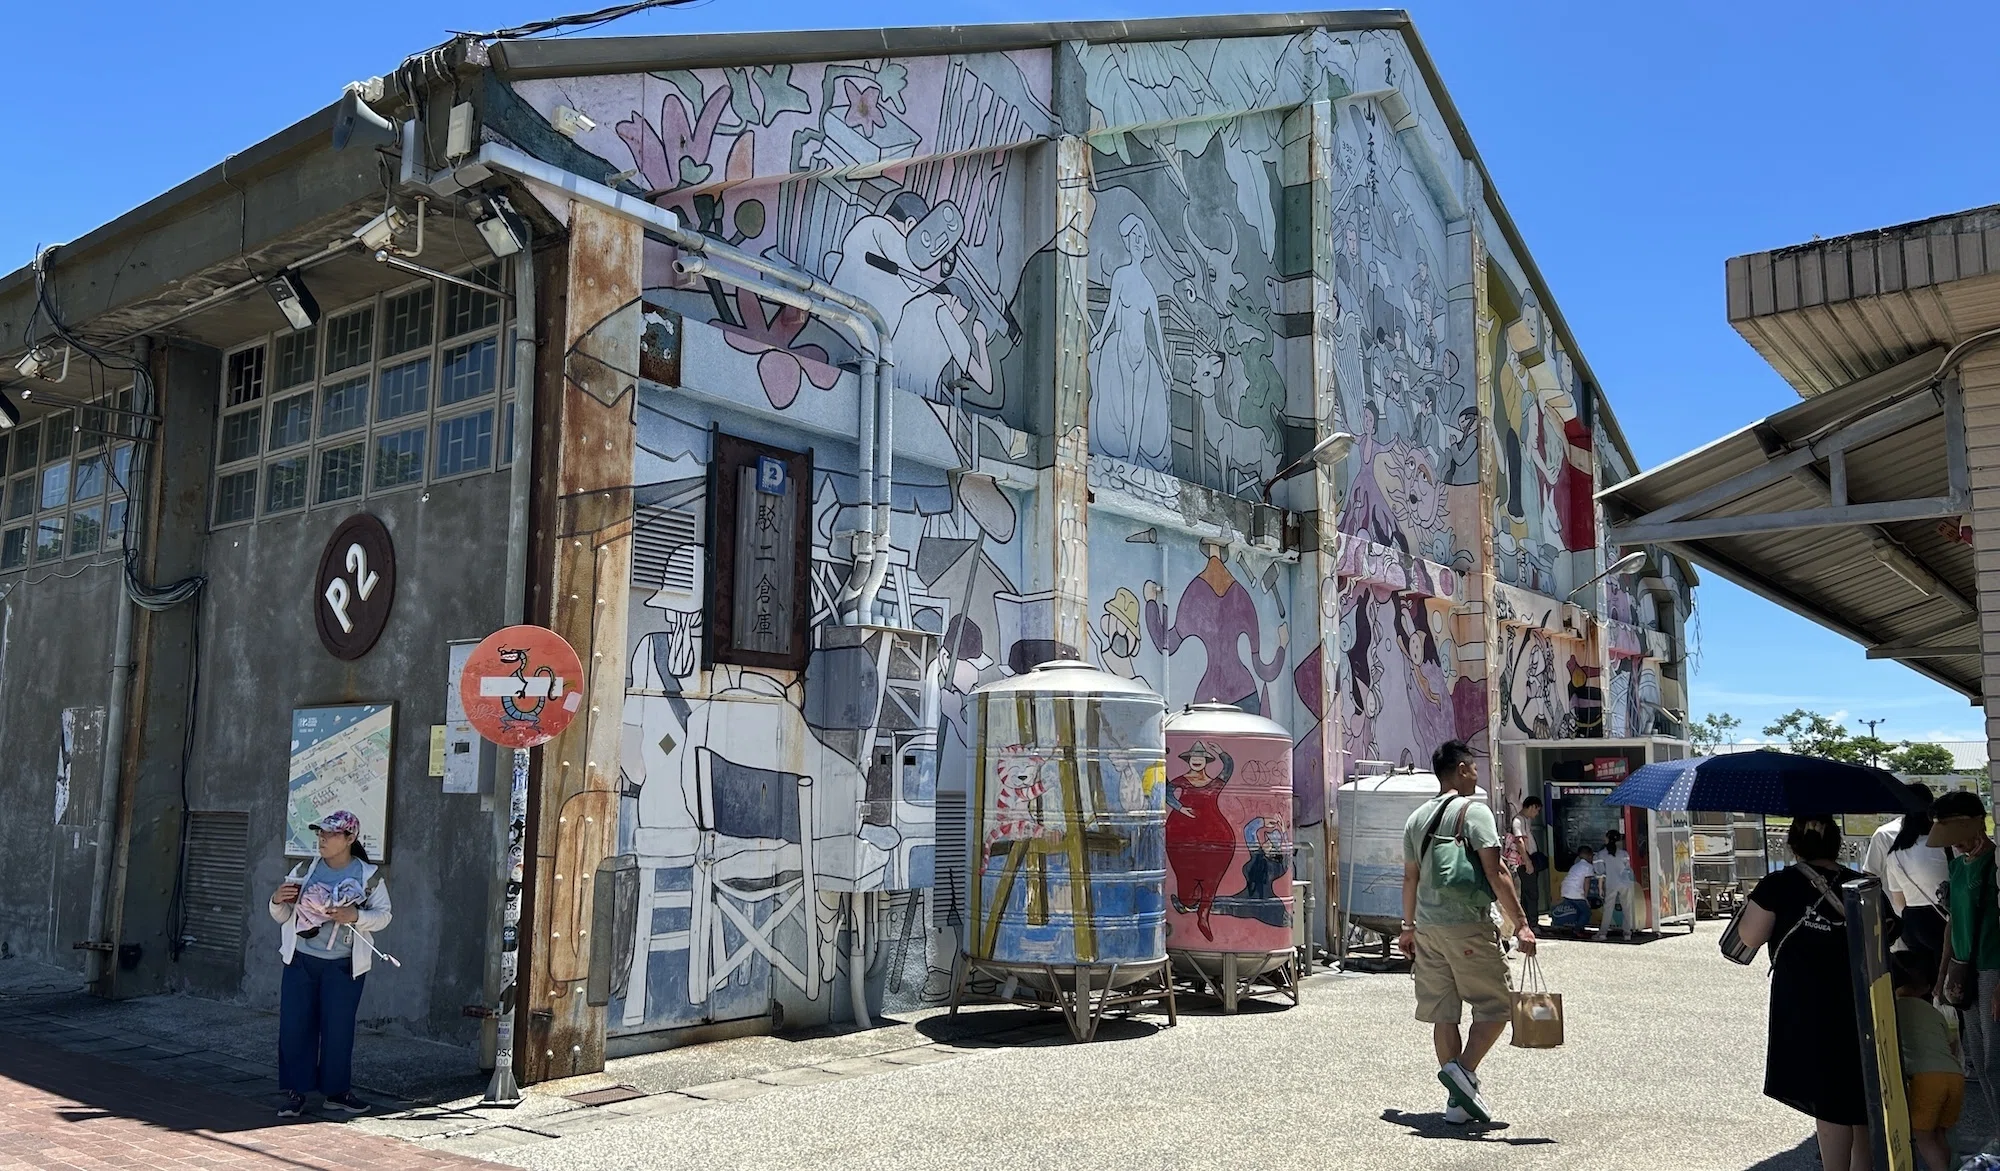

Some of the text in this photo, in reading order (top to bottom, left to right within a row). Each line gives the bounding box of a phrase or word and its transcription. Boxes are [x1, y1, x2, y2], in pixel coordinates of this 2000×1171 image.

[325, 542, 380, 634] P2
[752, 504, 780, 642] 駁二倉庫
